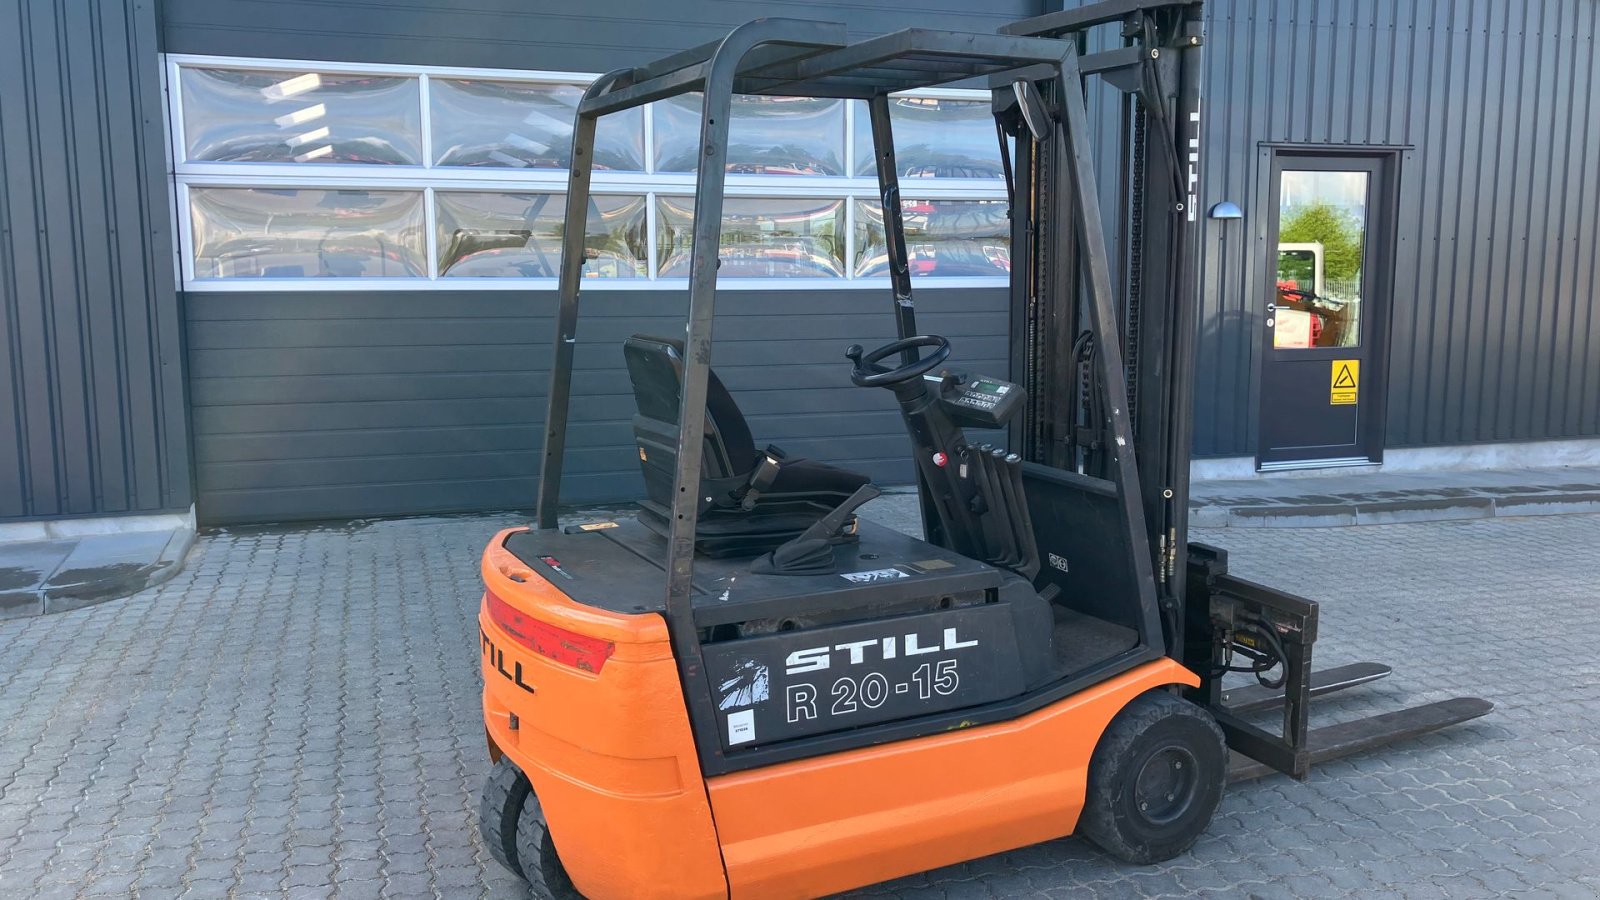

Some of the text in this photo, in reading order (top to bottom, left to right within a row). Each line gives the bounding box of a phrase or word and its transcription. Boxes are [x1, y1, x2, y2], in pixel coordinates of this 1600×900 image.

[478, 620, 535, 694] TILL
[785, 627, 979, 675] STILL
[787, 658, 960, 723] R 20-15
